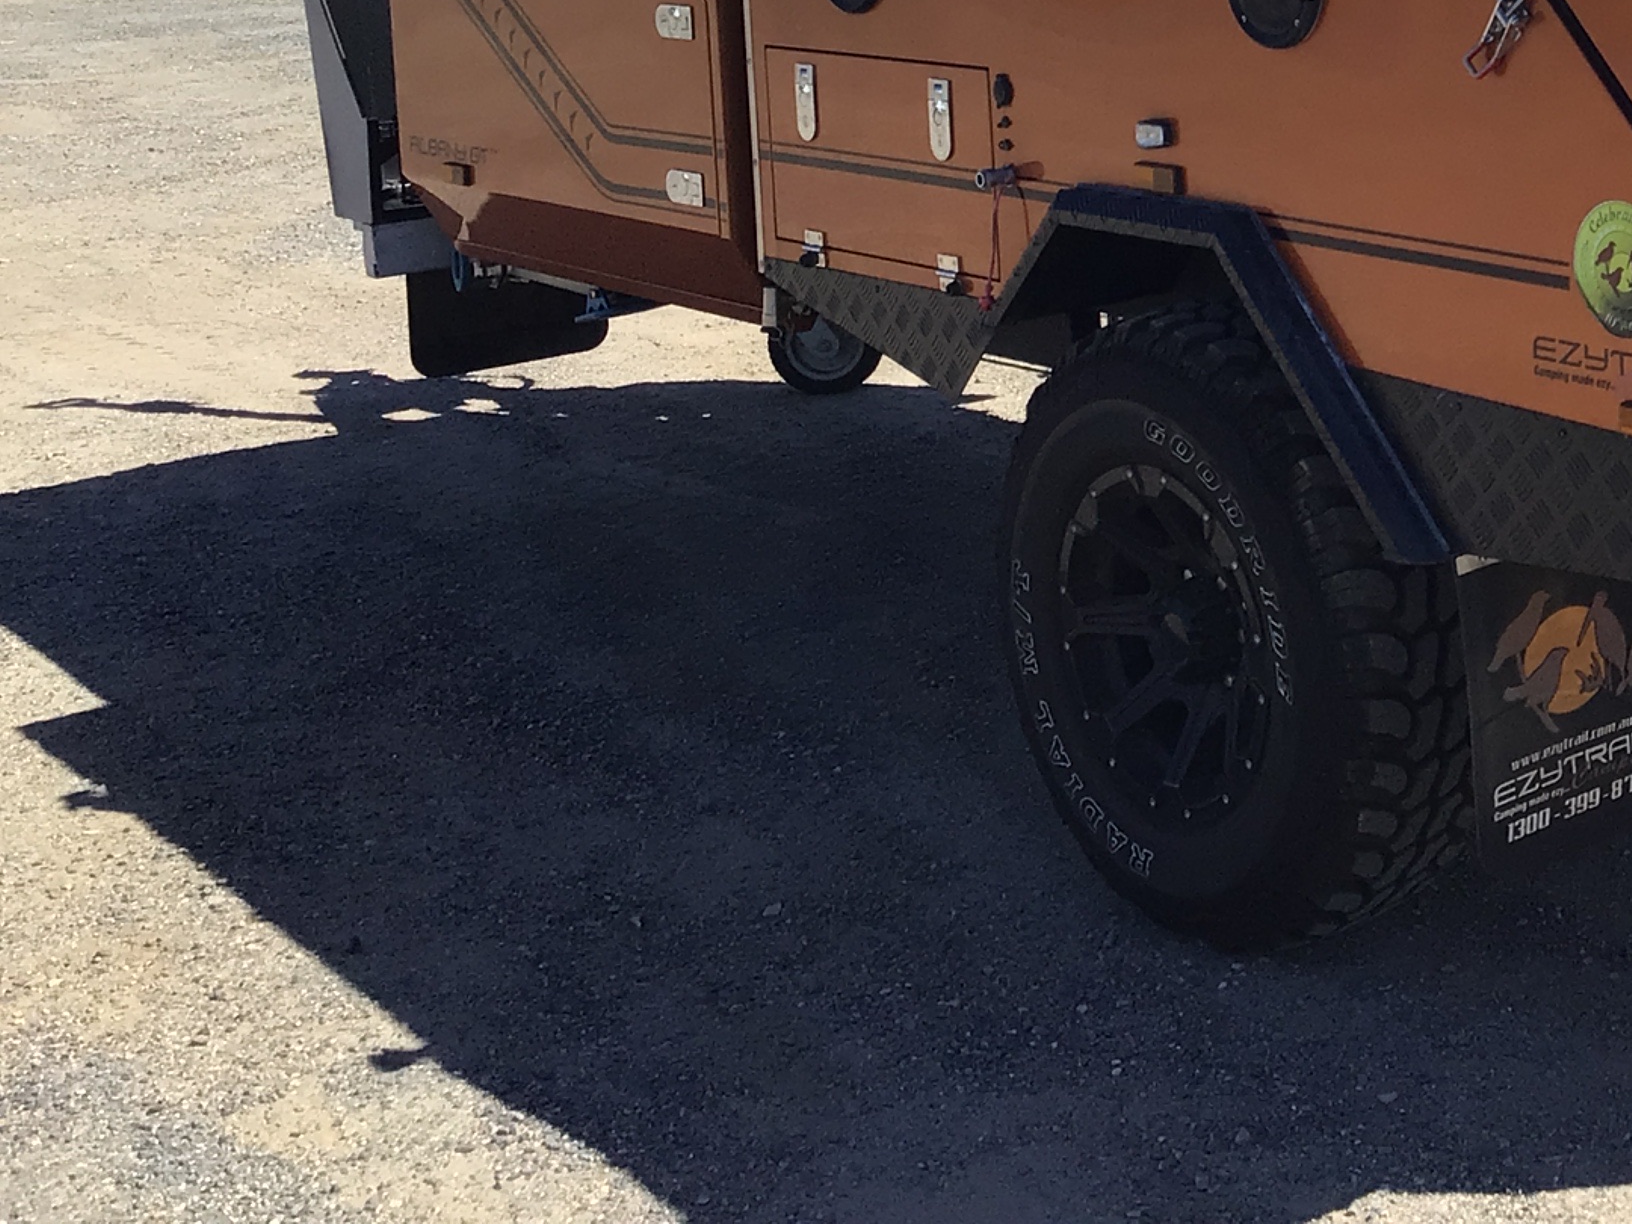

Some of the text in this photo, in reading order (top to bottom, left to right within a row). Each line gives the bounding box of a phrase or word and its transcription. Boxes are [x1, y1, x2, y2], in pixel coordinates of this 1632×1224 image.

[1011, 558, 1039, 676] M/T
[1142, 417, 1294, 706] GOODRIDE
[1035, 700, 1155, 880] RADIAL
